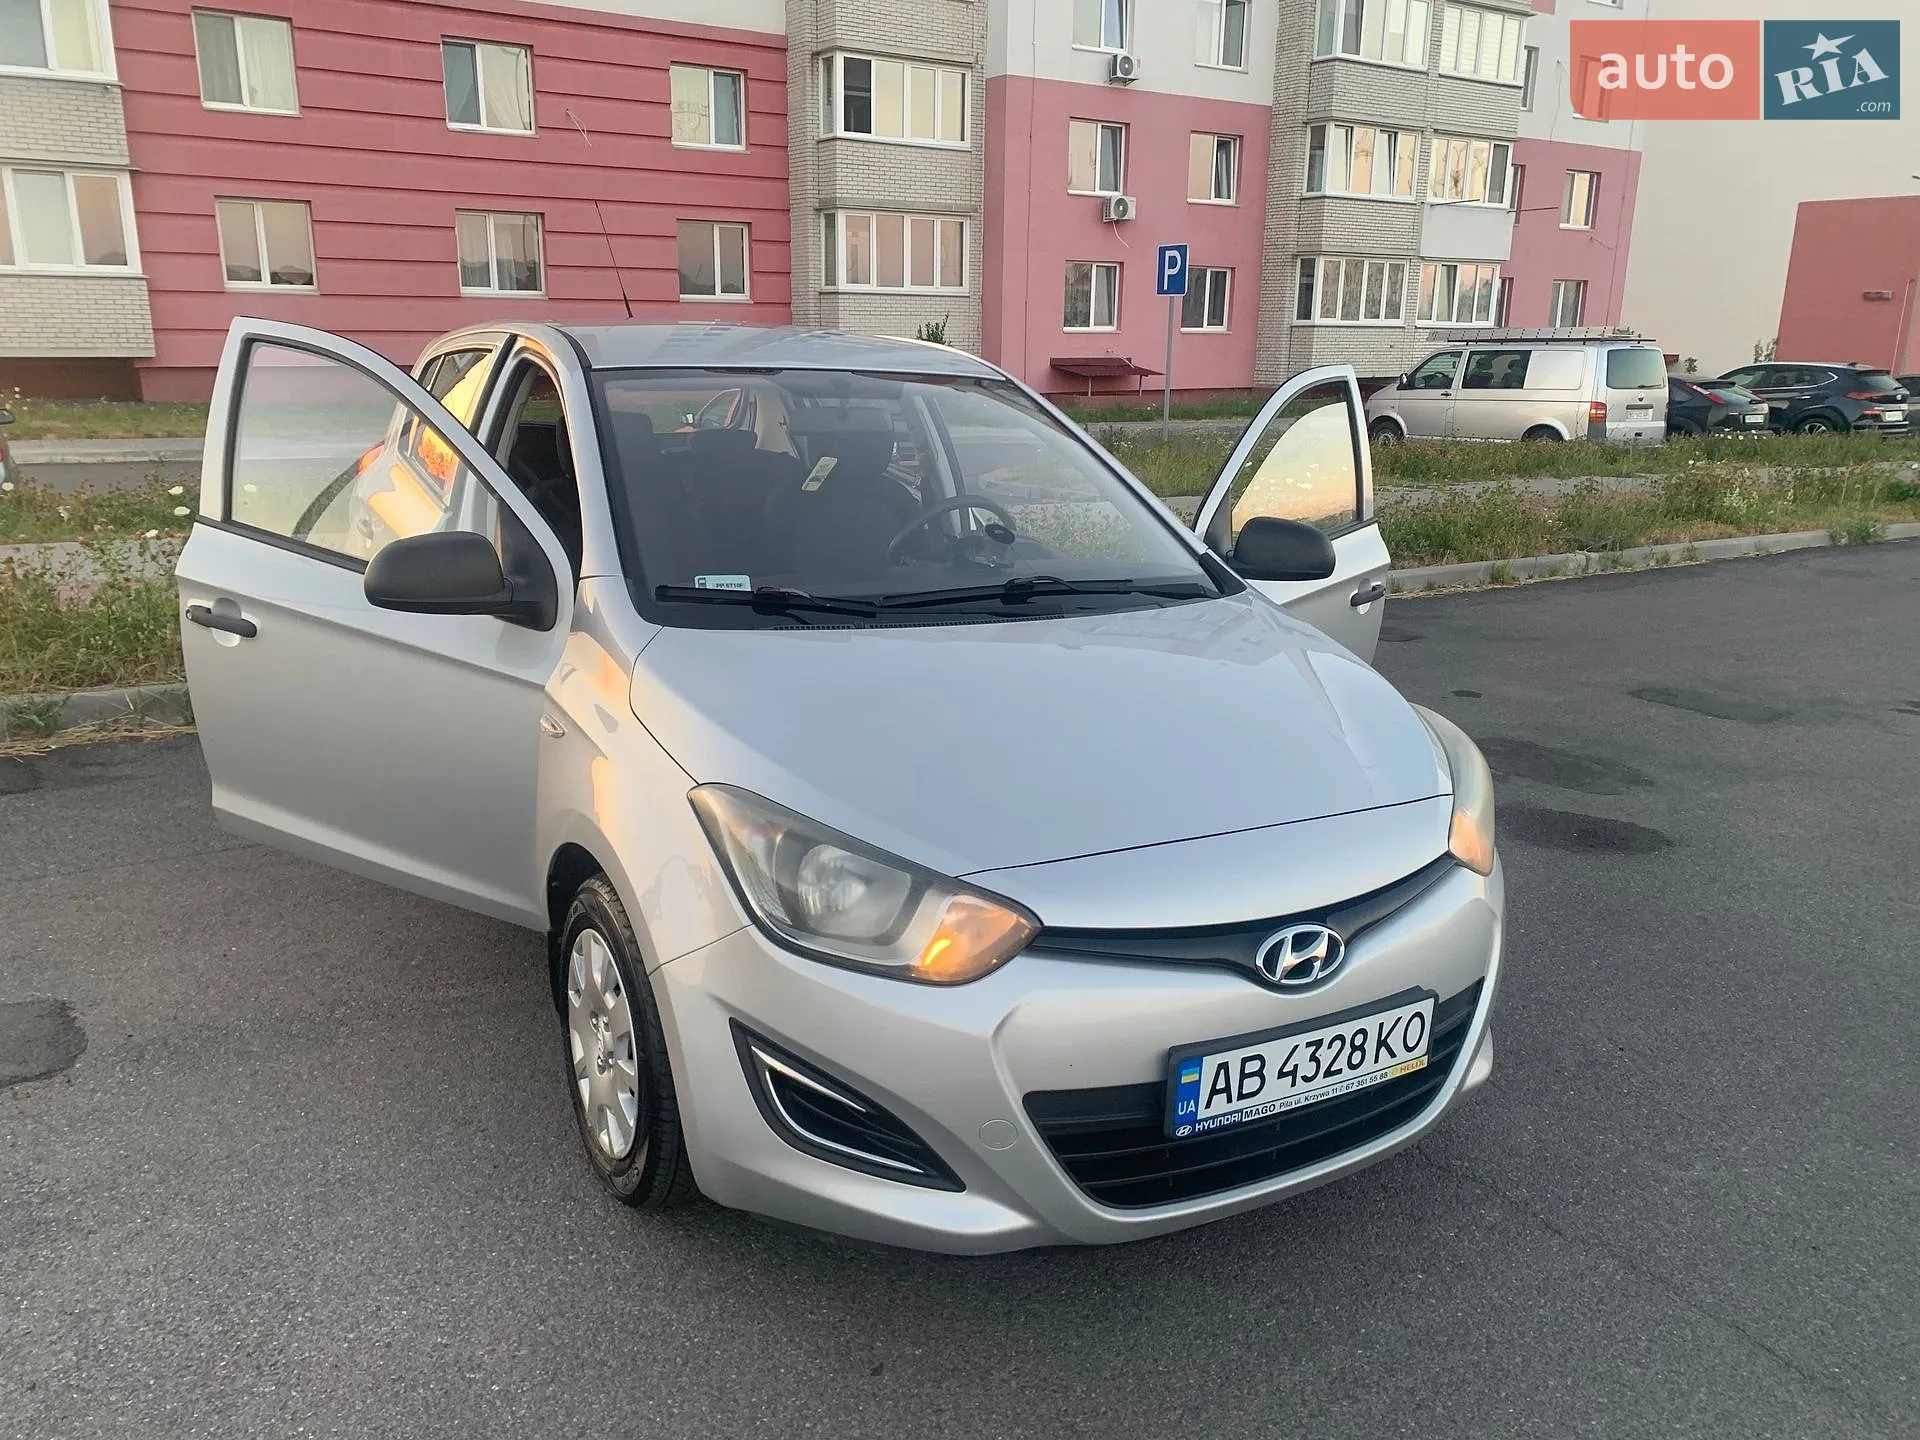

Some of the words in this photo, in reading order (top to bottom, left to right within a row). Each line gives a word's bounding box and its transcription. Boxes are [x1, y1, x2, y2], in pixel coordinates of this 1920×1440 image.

[1164, 250, 1181, 290] P
[1204, 1053, 1266, 1110] AB
[1276, 1027, 1369, 1088] 4328
[1374, 1011, 1426, 1064] KO
[1178, 1099, 1196, 1115] UA
[1195, 1112, 1242, 1132] HYUNDAI
[1244, 1103, 1276, 1120] MAGO
